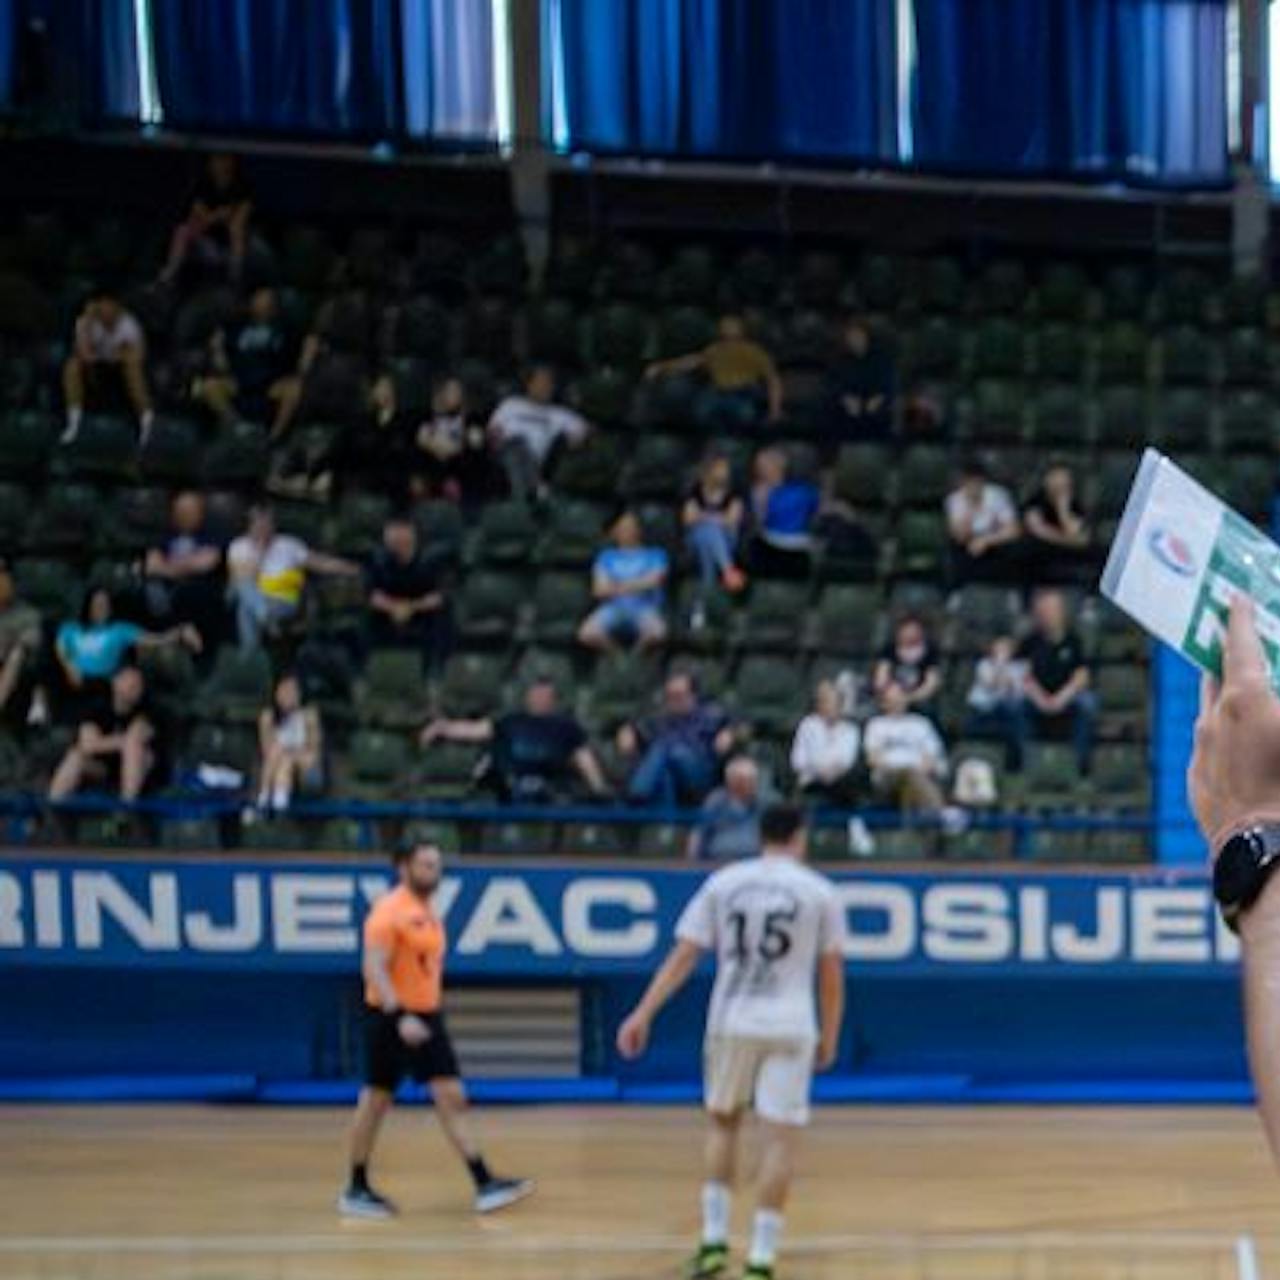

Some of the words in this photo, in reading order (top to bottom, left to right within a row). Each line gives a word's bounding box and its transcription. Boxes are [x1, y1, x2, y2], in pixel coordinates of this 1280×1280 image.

[0, 869, 657, 957] INJEAC
[832, 882, 1242, 962] OSIJE
[727, 902, 798, 964] 15
